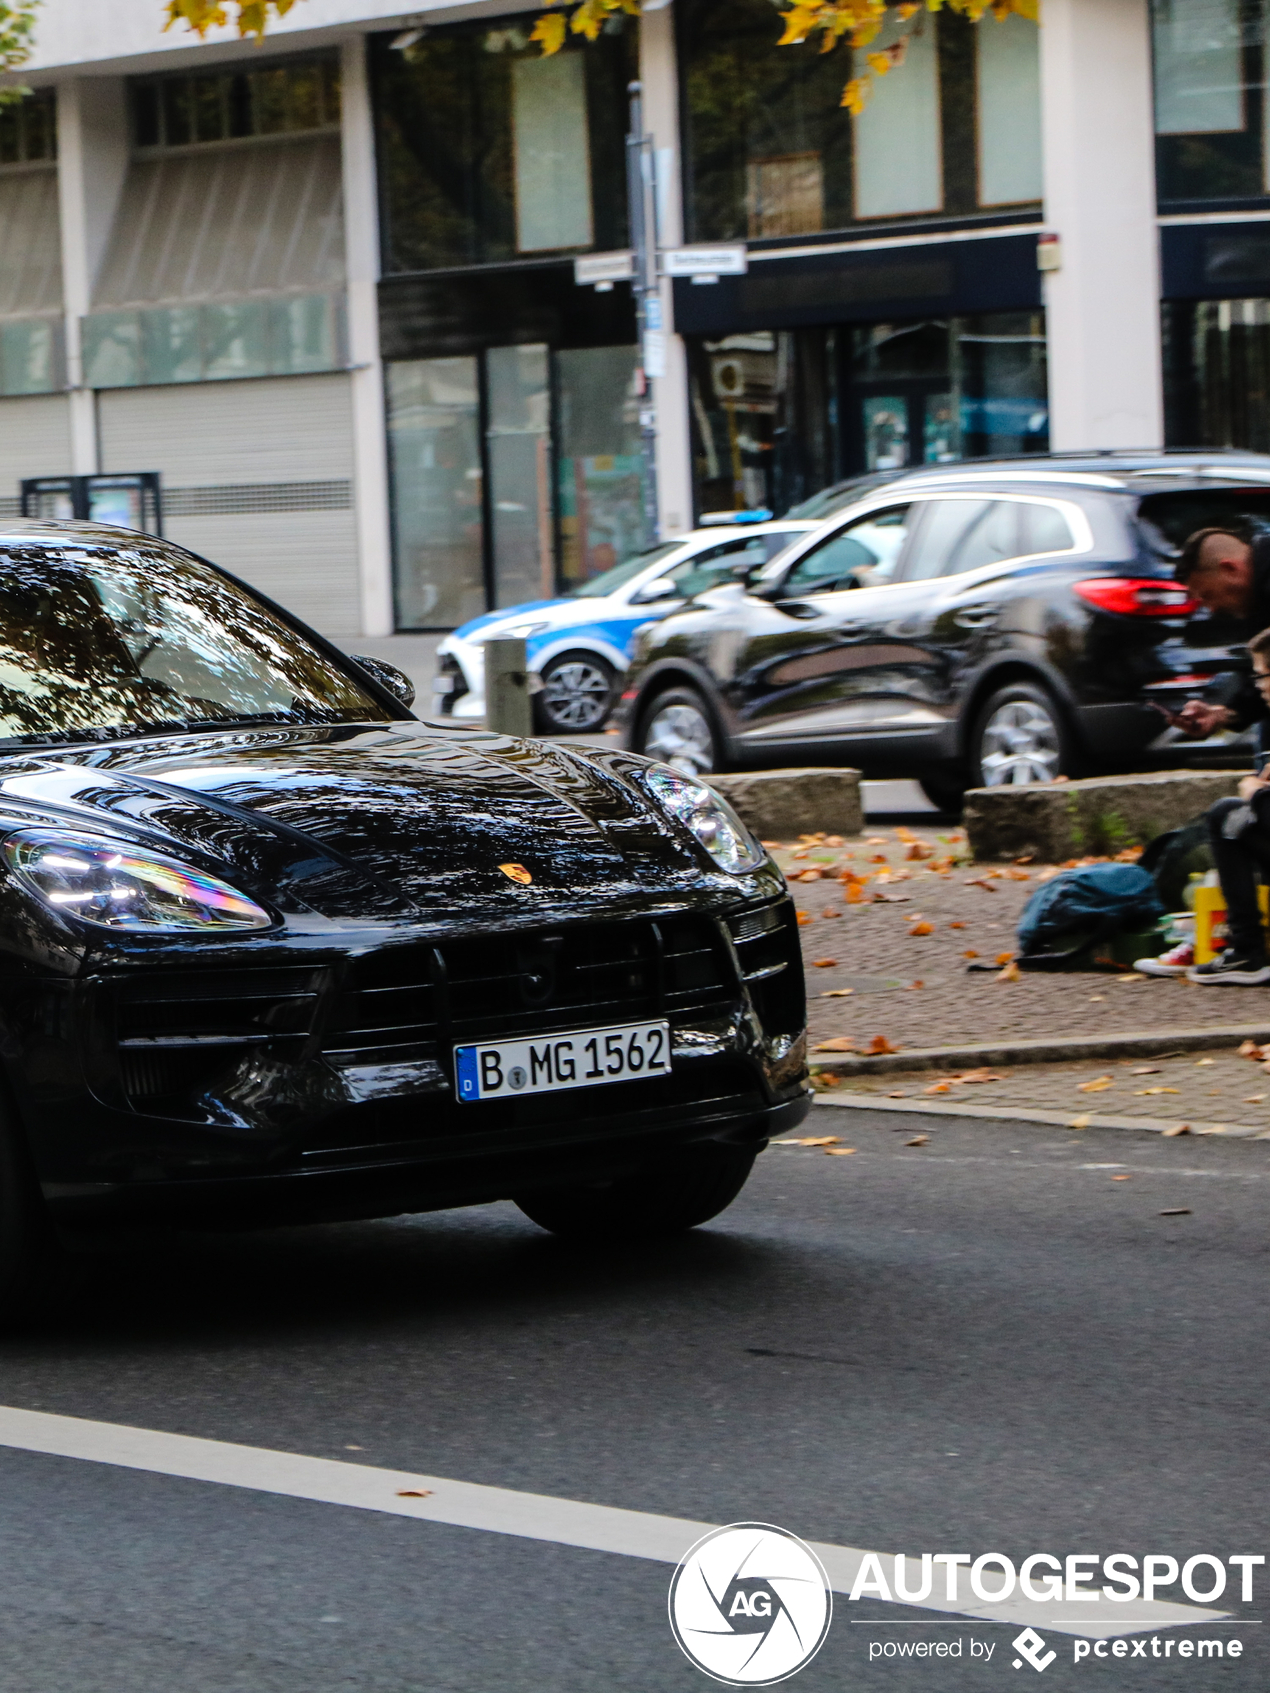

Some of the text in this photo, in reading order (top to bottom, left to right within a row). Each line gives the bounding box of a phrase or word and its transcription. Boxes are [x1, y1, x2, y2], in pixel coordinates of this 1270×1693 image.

[463, 1079, 473, 1091] D
[480, 1050, 503, 1091] B
[584, 1029, 665, 1078] 1562
